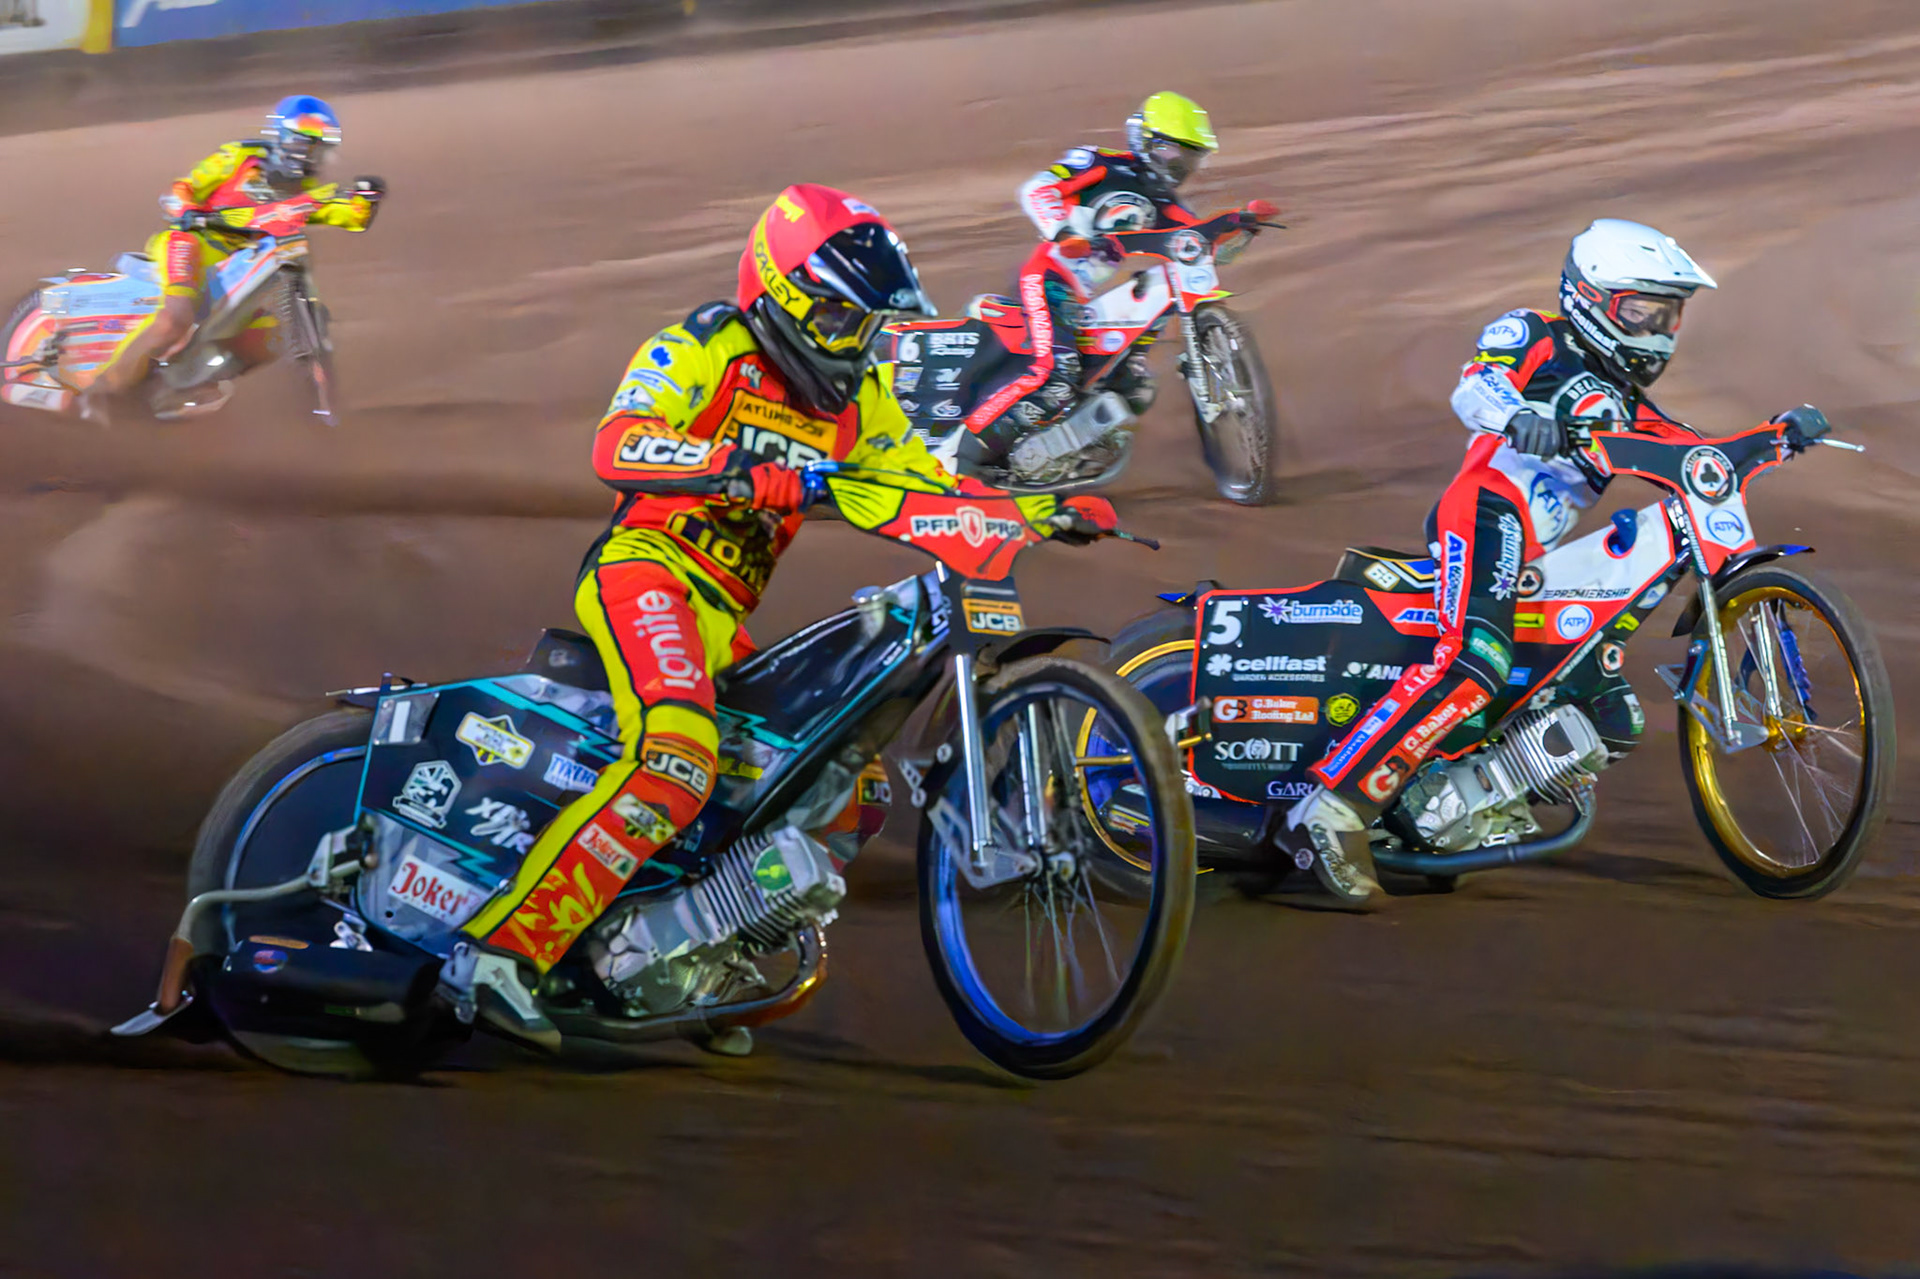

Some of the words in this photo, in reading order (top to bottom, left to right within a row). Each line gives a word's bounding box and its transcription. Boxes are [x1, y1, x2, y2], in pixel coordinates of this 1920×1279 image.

[754, 241, 801, 305] OAKLEY
[899, 334, 919, 361] 6
[620, 436, 709, 465] JCB
[913, 518, 960, 534] PFP
[1551, 587, 1631, 600] PREMIERSHIP
[1291, 600, 1363, 617] burnside
[971, 612, 1021, 632] JCB
[1206, 600, 1243, 646] 5
[1234, 655, 1327, 671] cellfast
[1214, 738, 1304, 763] SCOTT
[646, 752, 708, 792] JCB
[392, 861, 470, 916] Joker
